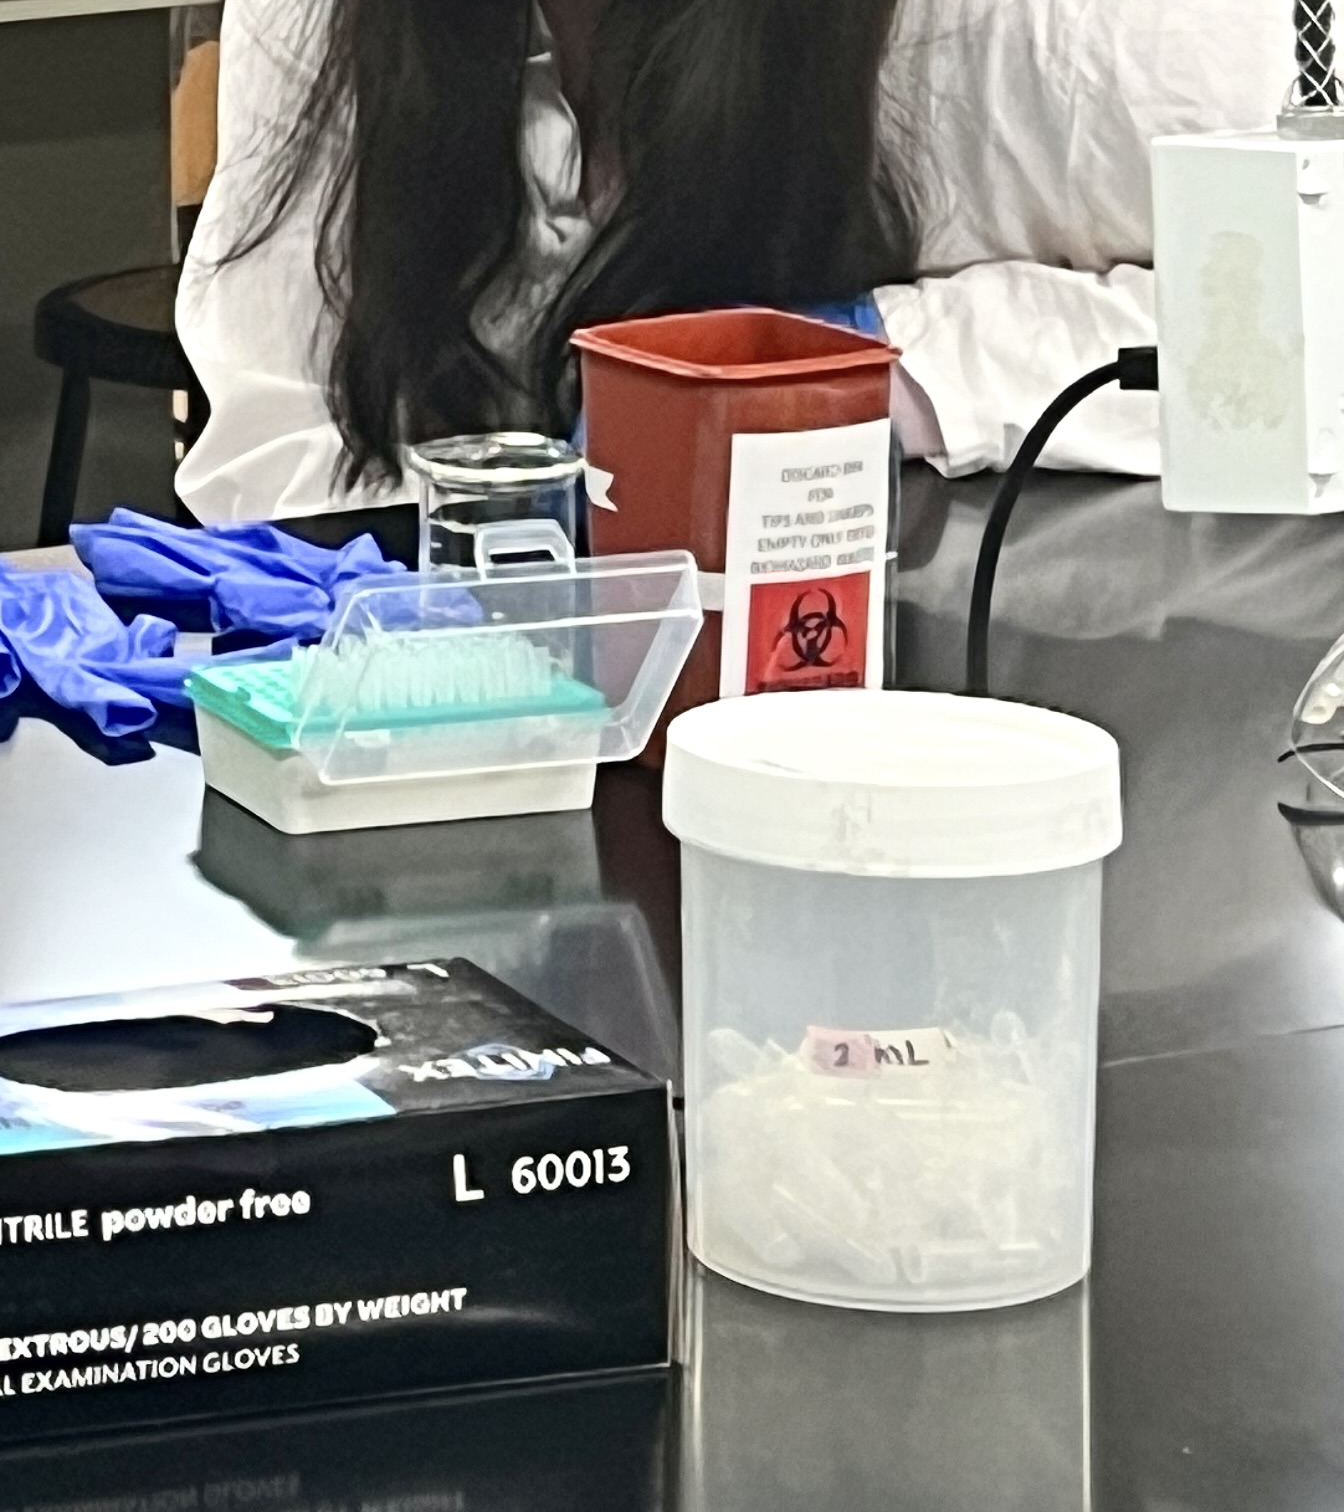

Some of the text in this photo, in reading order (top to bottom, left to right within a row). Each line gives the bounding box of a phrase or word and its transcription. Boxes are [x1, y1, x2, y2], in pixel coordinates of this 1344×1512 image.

[757, 534, 808, 554] EMPTY
[761, 513, 792, 530] TIPS
[794, 509, 825, 528] AND
[833, 1041, 850, 1067] 2
[451, 1144, 633, 1203] L 60013
[100, 1194, 235, 1242] powder
[238, 1188, 312, 1221] free
[200, 1304, 312, 1341] GLOVES
[313, 1300, 354, 1329] BY
[356, 1286, 469, 1323] WEIGHT
[20, 1354, 199, 1396] EXAMINATION
[201, 1342, 302, 1376] GLOVES
